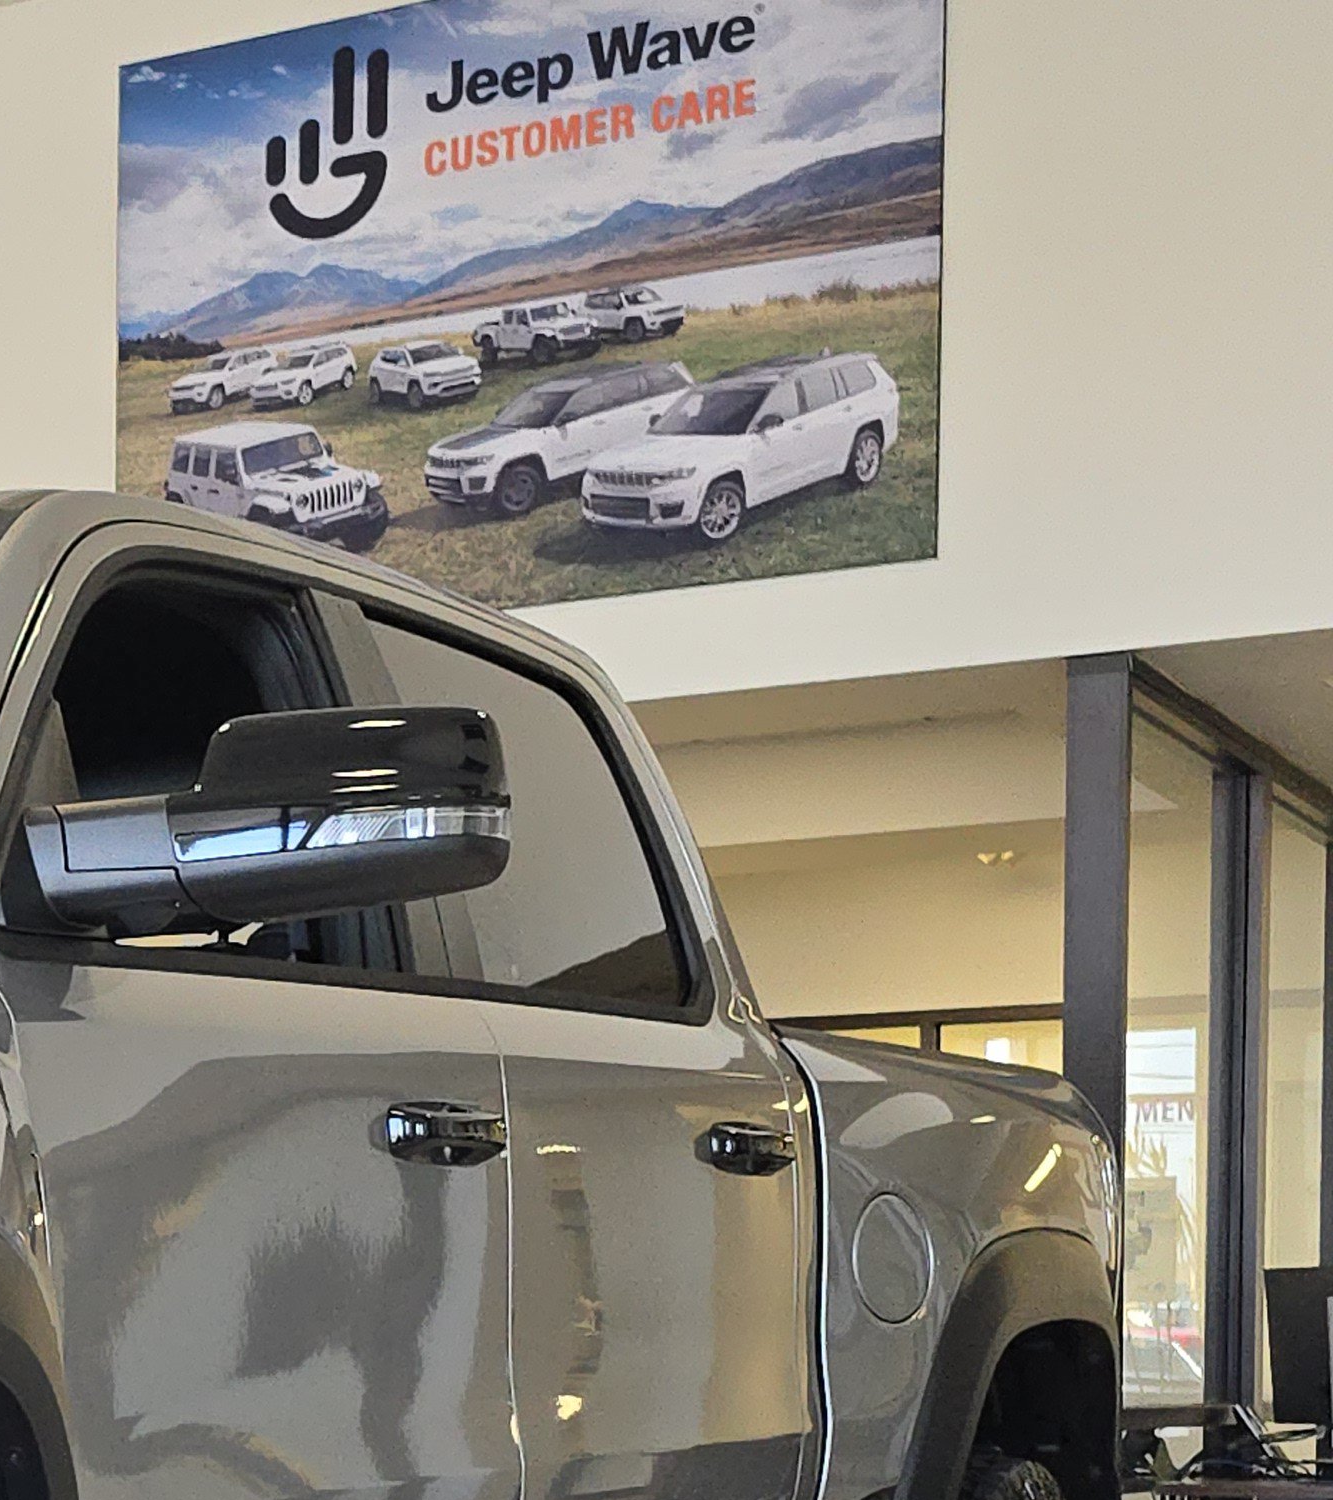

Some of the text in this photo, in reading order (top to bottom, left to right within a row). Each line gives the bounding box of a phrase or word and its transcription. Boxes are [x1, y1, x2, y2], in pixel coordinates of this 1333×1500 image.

[426, 14, 756, 113] Jeep Wave
[424, 78, 757, 177] CUSTOMER CARE
